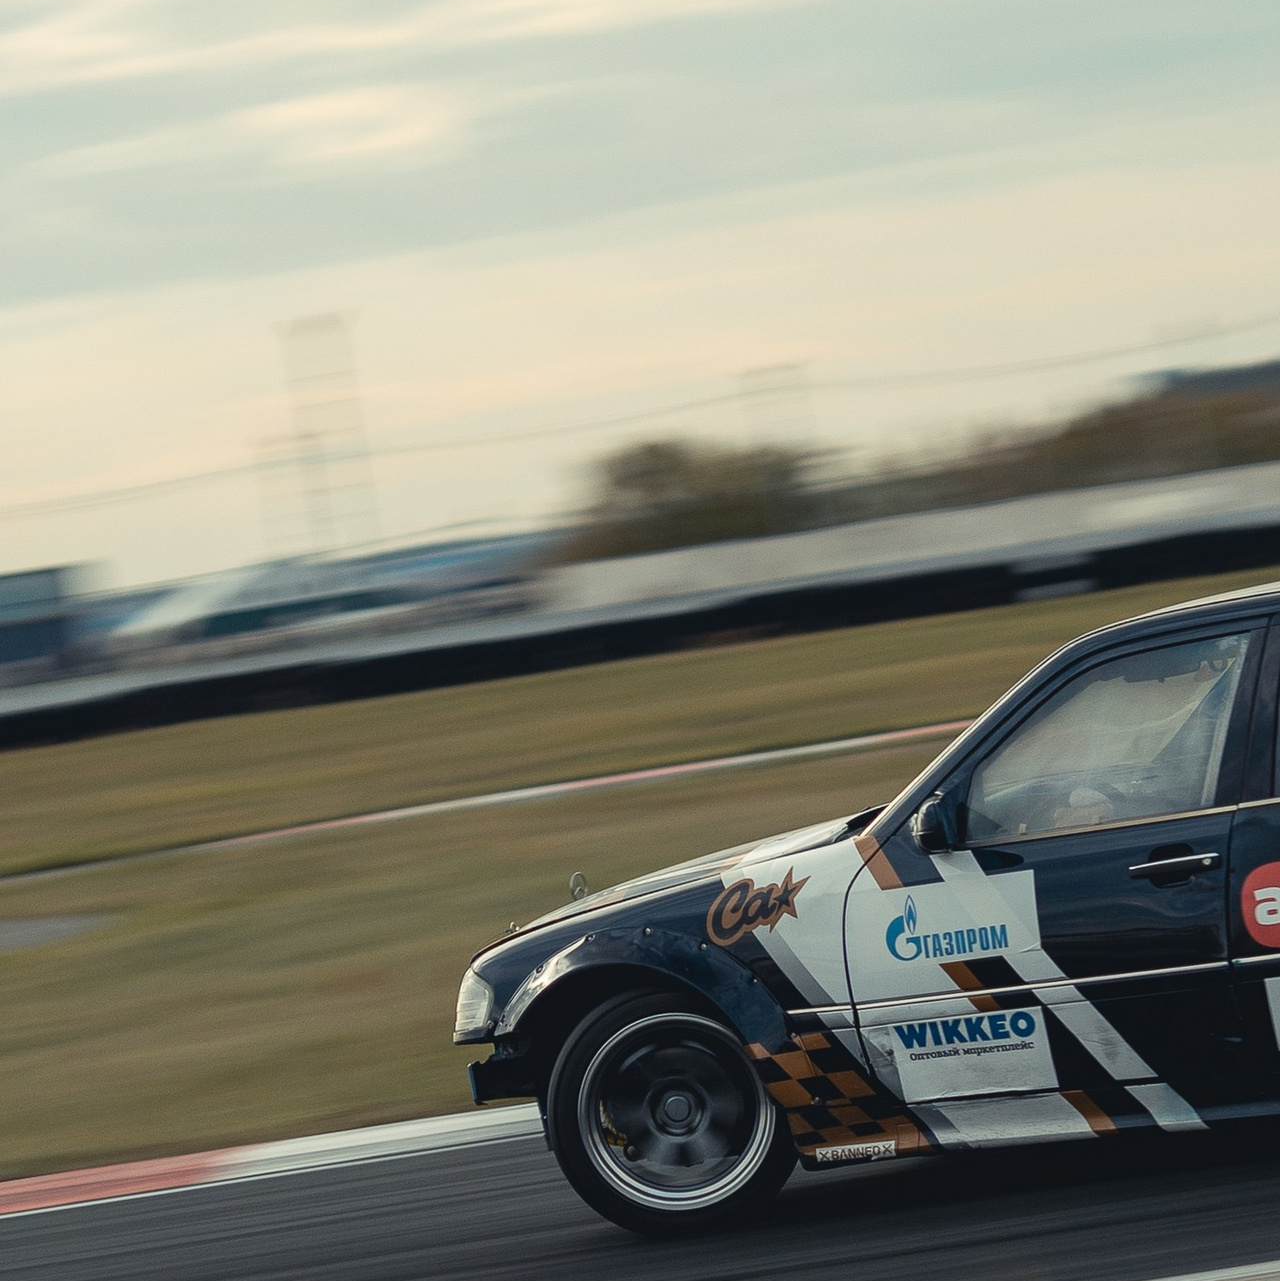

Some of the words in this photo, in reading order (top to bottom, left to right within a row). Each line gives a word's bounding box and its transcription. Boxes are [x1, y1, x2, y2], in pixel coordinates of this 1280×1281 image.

[893, 1011, 1036, 1050] WIKKEO
[909, 1047, 961, 1061] Оптовый
[963, 1040, 1035, 1056] маркетплейс
